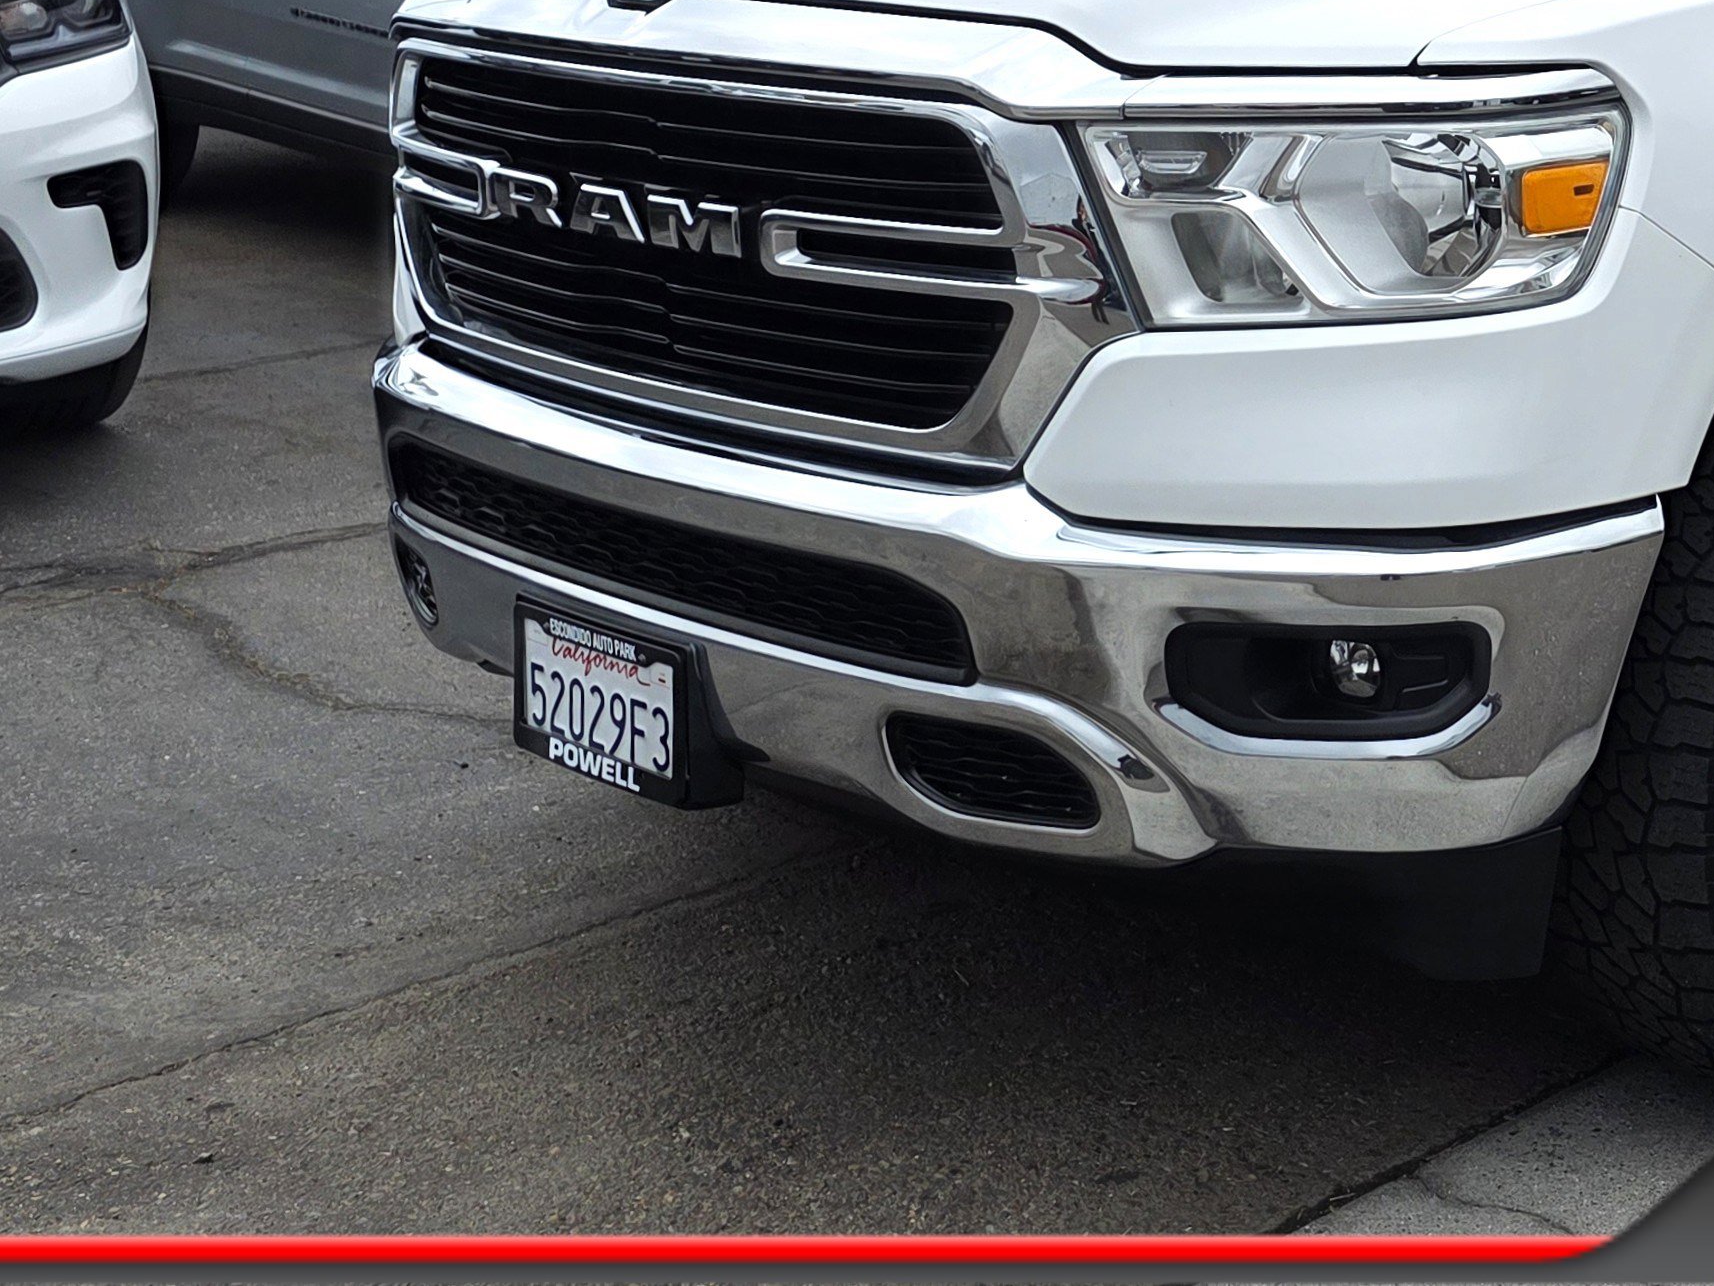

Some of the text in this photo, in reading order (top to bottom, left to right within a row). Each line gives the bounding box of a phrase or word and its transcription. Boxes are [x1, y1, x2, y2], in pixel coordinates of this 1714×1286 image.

[495, 166, 742, 258] RAM
[549, 618, 637, 662] ESCONDIDO AUTO PARK
[551, 637, 652, 687] California
[530, 662, 670, 773] 52029F3
[549, 736, 641, 792] POWELL
